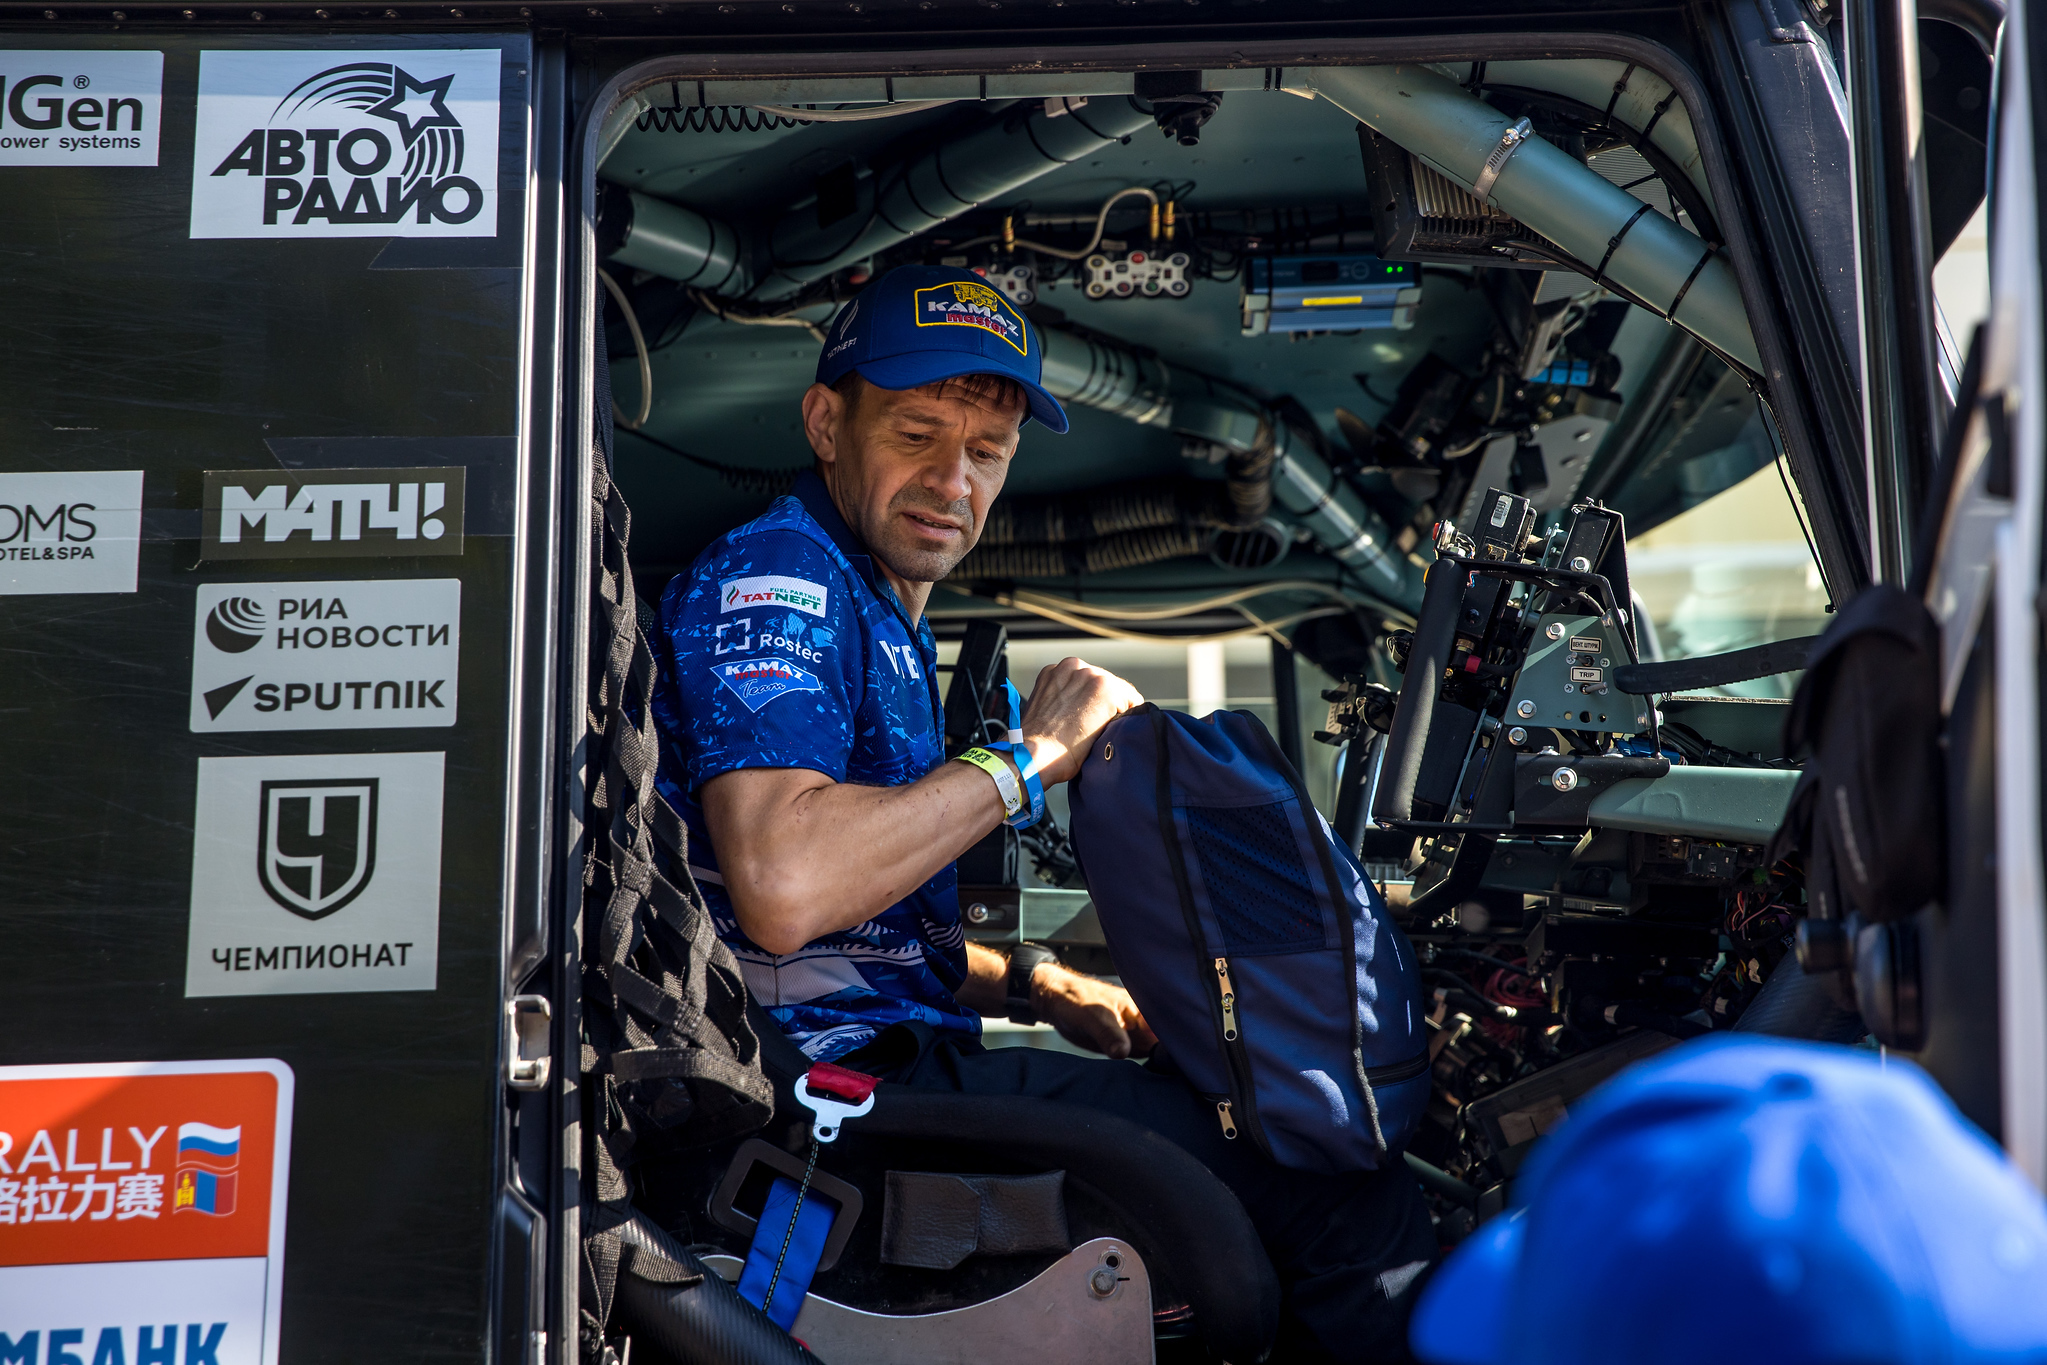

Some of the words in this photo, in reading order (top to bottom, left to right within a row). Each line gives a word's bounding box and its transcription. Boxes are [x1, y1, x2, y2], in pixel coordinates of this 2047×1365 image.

[59, 134, 141, 151] systems
[210, 128, 392, 177] АВТО
[262, 175, 484, 225] РАДИО
[928, 301, 1019, 336] KAMAZ
[946, 313, 1008, 336] master
[220, 483, 445, 543] МАТЧ!
[741, 592, 822, 610] TATNEFT
[790, 589, 822, 603] PARTNER
[278, 598, 349, 620] РИА
[277, 623, 450, 650] НОВОСТИ
[760, 633, 823, 663] Rostec
[725, 661, 804, 682] KAMAZ
[735, 668, 791, 680] master
[253, 679, 445, 712] SPUTNIK
[739, 679, 786, 698] Team
[213, 943, 413, 971] ЧЕМПИОНАТ
